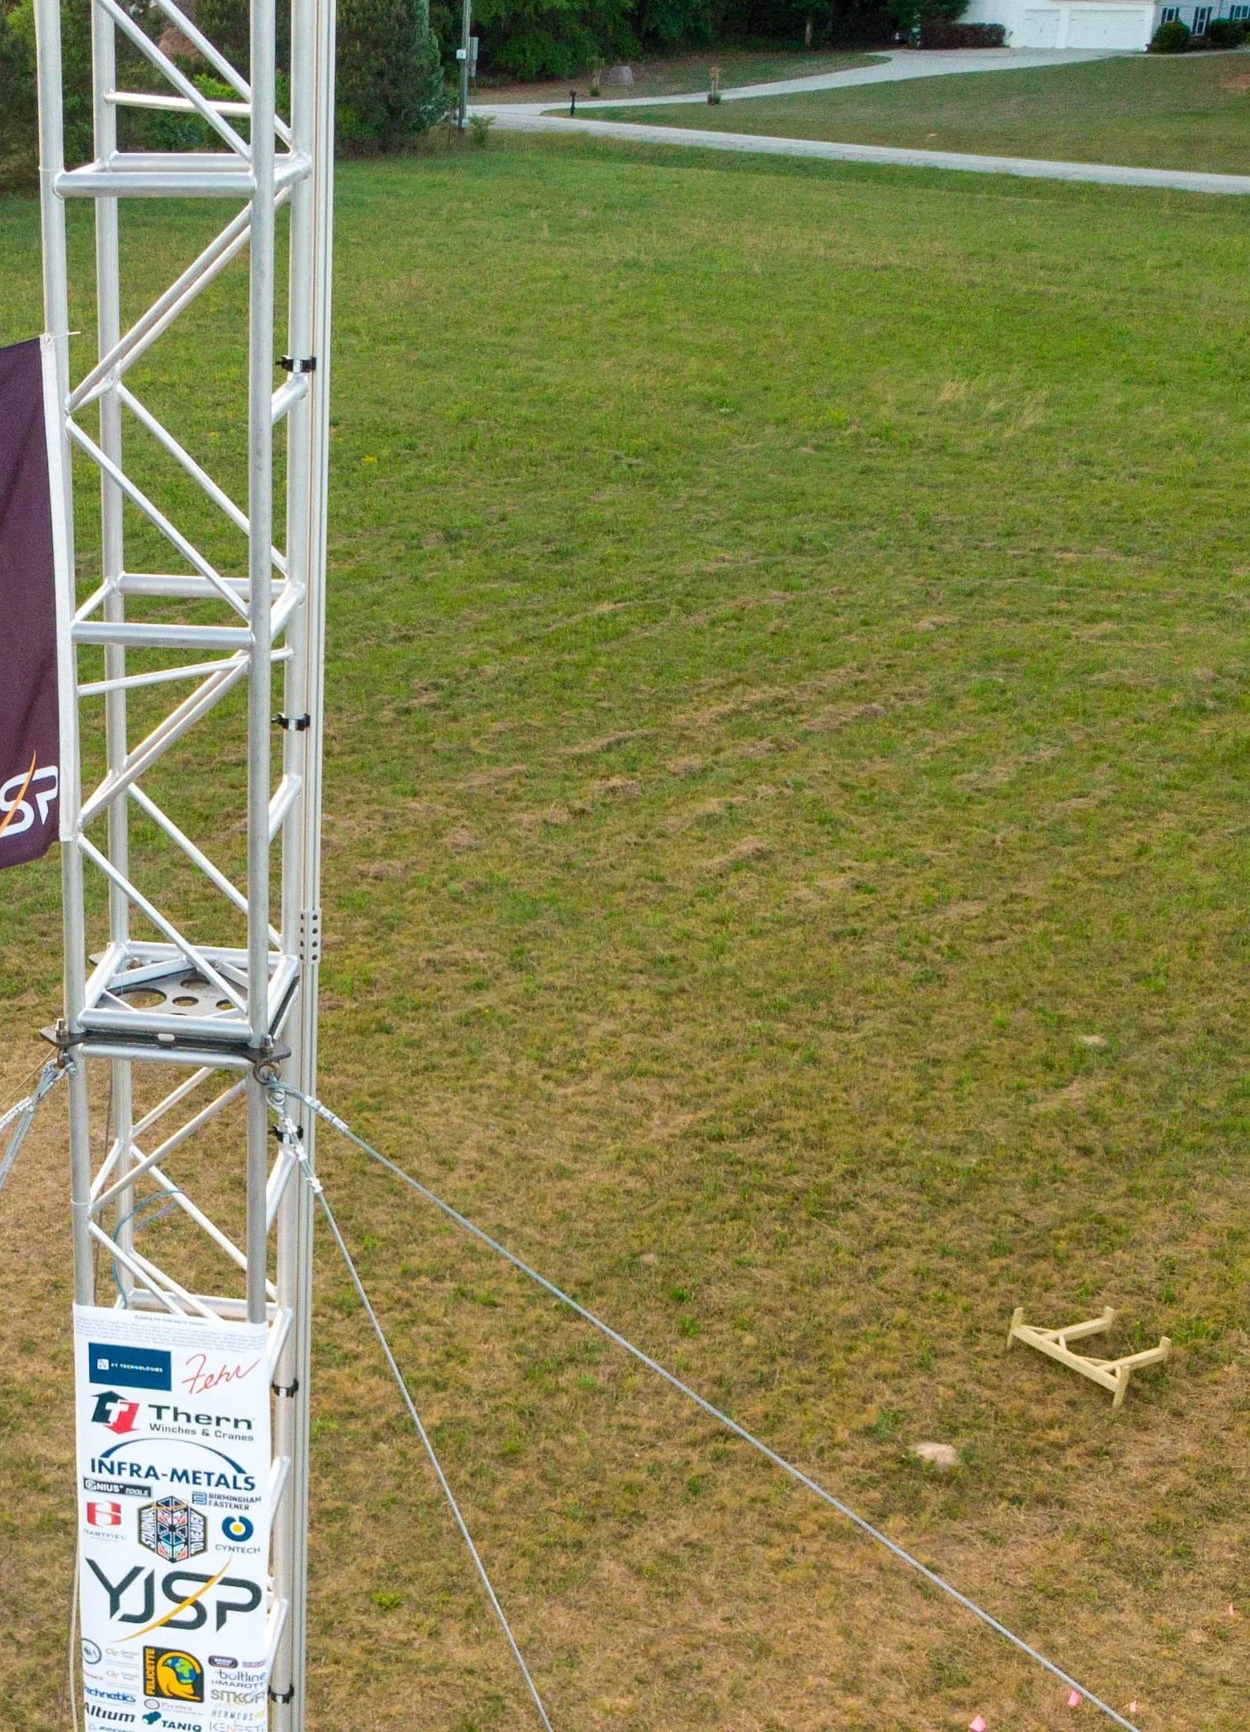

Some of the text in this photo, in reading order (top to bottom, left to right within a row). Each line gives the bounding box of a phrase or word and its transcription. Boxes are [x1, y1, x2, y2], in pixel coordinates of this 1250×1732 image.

[181, 1353, 261, 1394] Fehr
[148, 1404, 254, 1431] Thern
[149, 1423, 254, 1442] Winches & Cranes
[91, 1457, 256, 1491] INFRA-METALS
[208, 1492, 262, 1504] BIRMINGHAM
[208, 1500, 250, 1511] FASTENER
[215, 1543, 261, 1554] CYNTECH
[85, 1557, 262, 1632] YJSP
[83, 1702, 135, 1723] Altium
